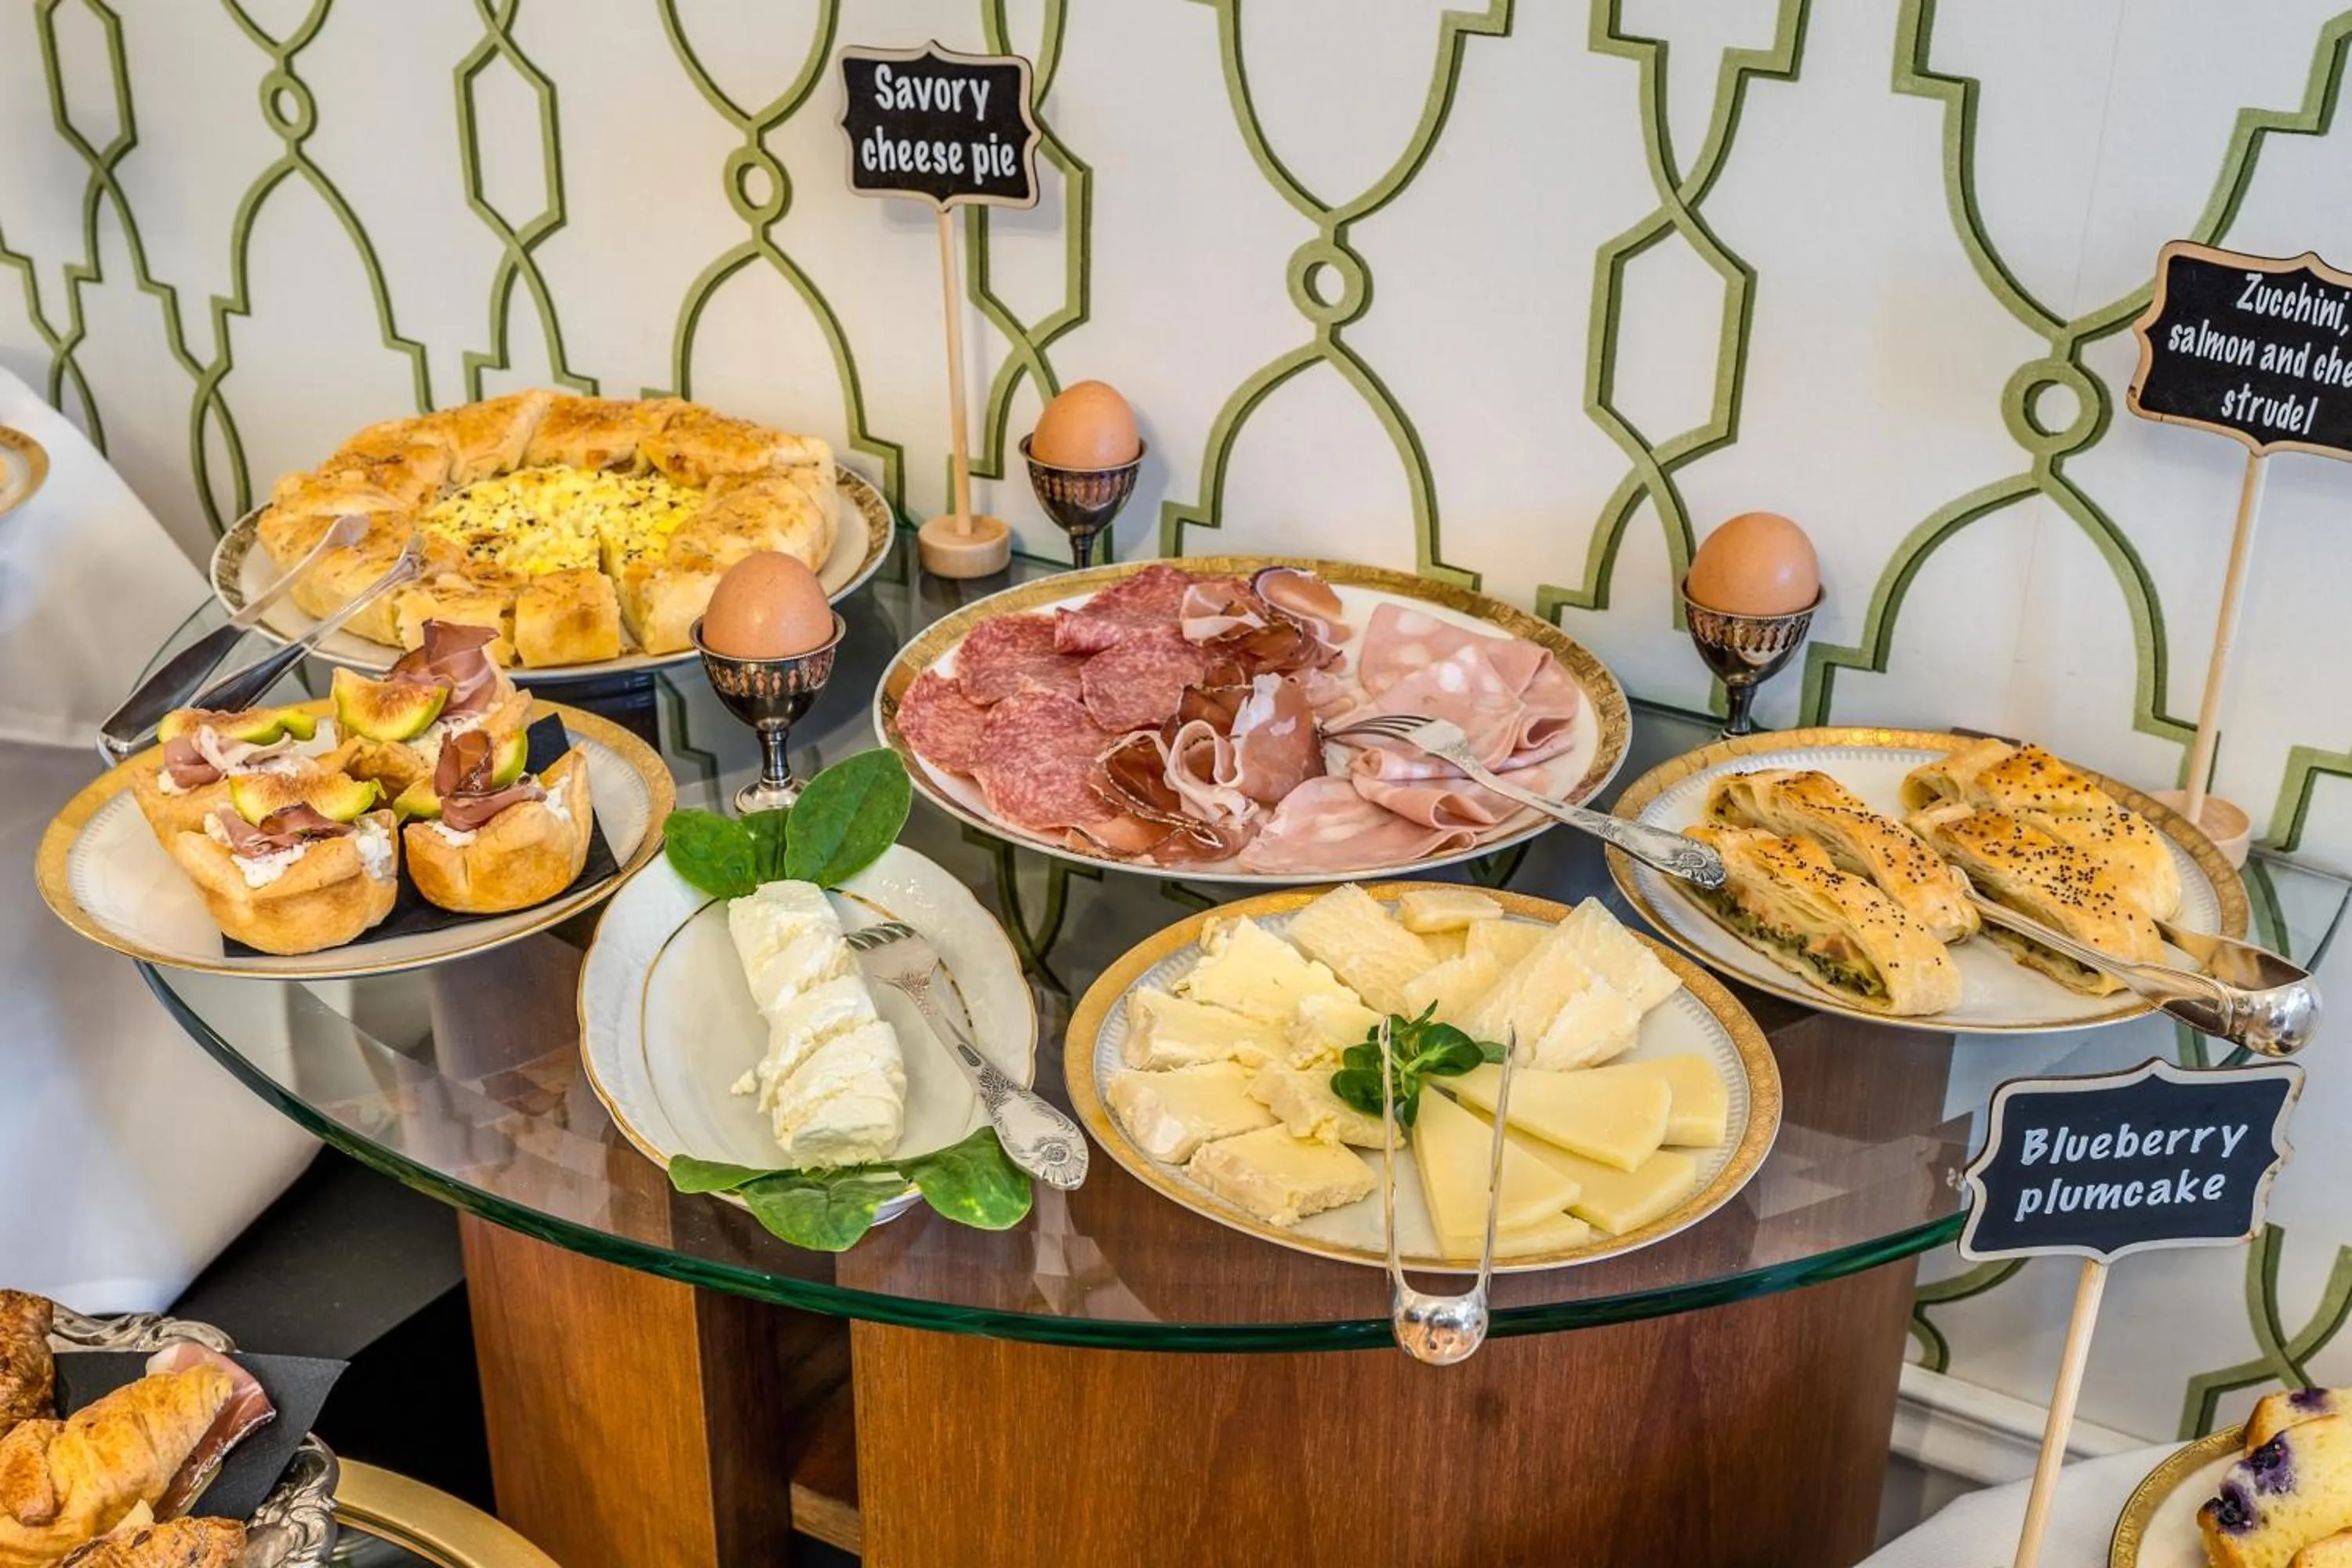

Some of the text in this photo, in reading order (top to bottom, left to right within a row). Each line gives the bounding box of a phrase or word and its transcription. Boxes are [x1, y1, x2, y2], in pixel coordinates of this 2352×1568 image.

[874, 64, 990, 121] Savory
[862, 125, 1017, 185] cheese pie
[2236, 272, 2350, 337] Zucchini,
[2168, 318, 2256, 366] salmon
[2259, 341, 2311, 379] and
[2221, 383, 2319, 435] strudel
[2020, 1123, 2249, 1166] Blueberry
[2014, 1168, 2226, 1222] plumcake
